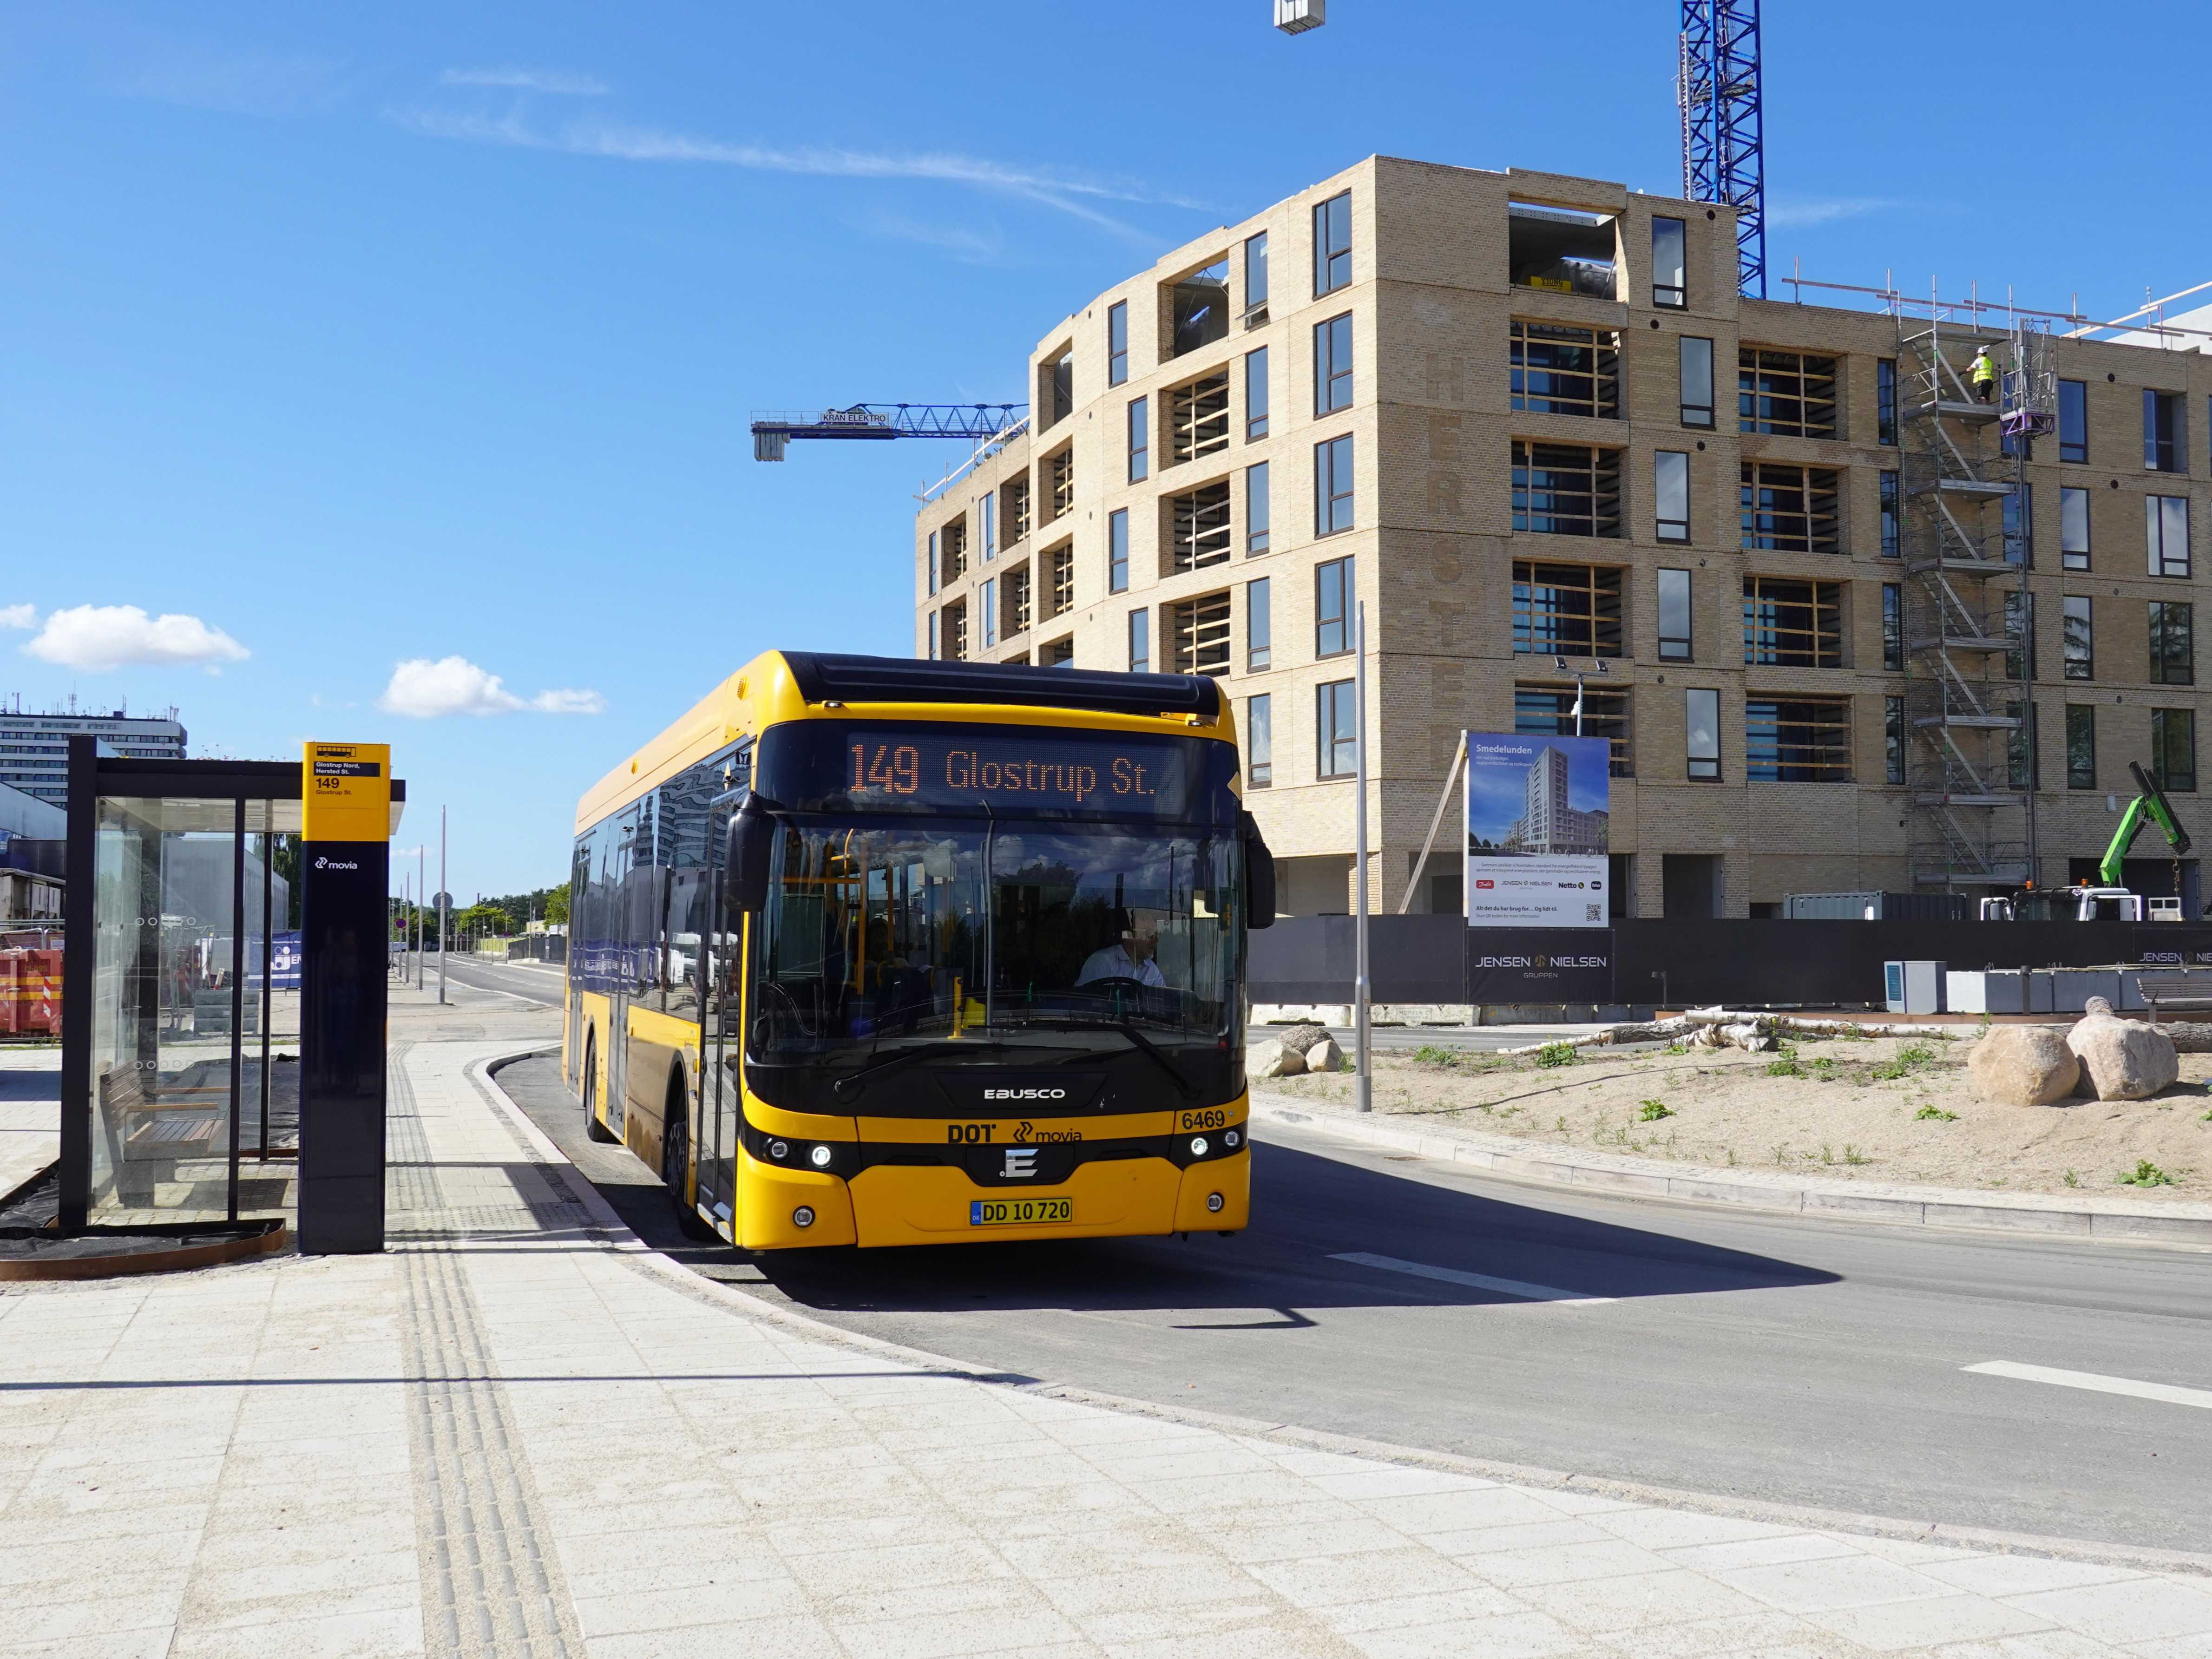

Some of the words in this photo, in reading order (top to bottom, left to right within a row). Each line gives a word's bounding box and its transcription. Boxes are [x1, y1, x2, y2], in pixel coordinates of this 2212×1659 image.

[1476, 744, 1532, 754] Smedelunden
[851, 744, 919, 793] 149
[946, 751, 1096, 802] Glostrup
[1113, 758, 1155, 794] St.
[316, 778, 340, 788] 149
[1476, 957, 1530, 967] JENSEN
[1550, 957, 1606, 967] NIELSEN
[2139, 952, 2184, 962] JENSEN
[984, 1089, 1065, 1099] EBUSCO
[1181, 1110, 1226, 1130] 6469
[1035, 1128, 1083, 1143] movia
[983, 1204, 1007, 1221] DD
[1014, 1203, 1033, 1220] 10
[1037, 1201, 1070, 1220] 720
